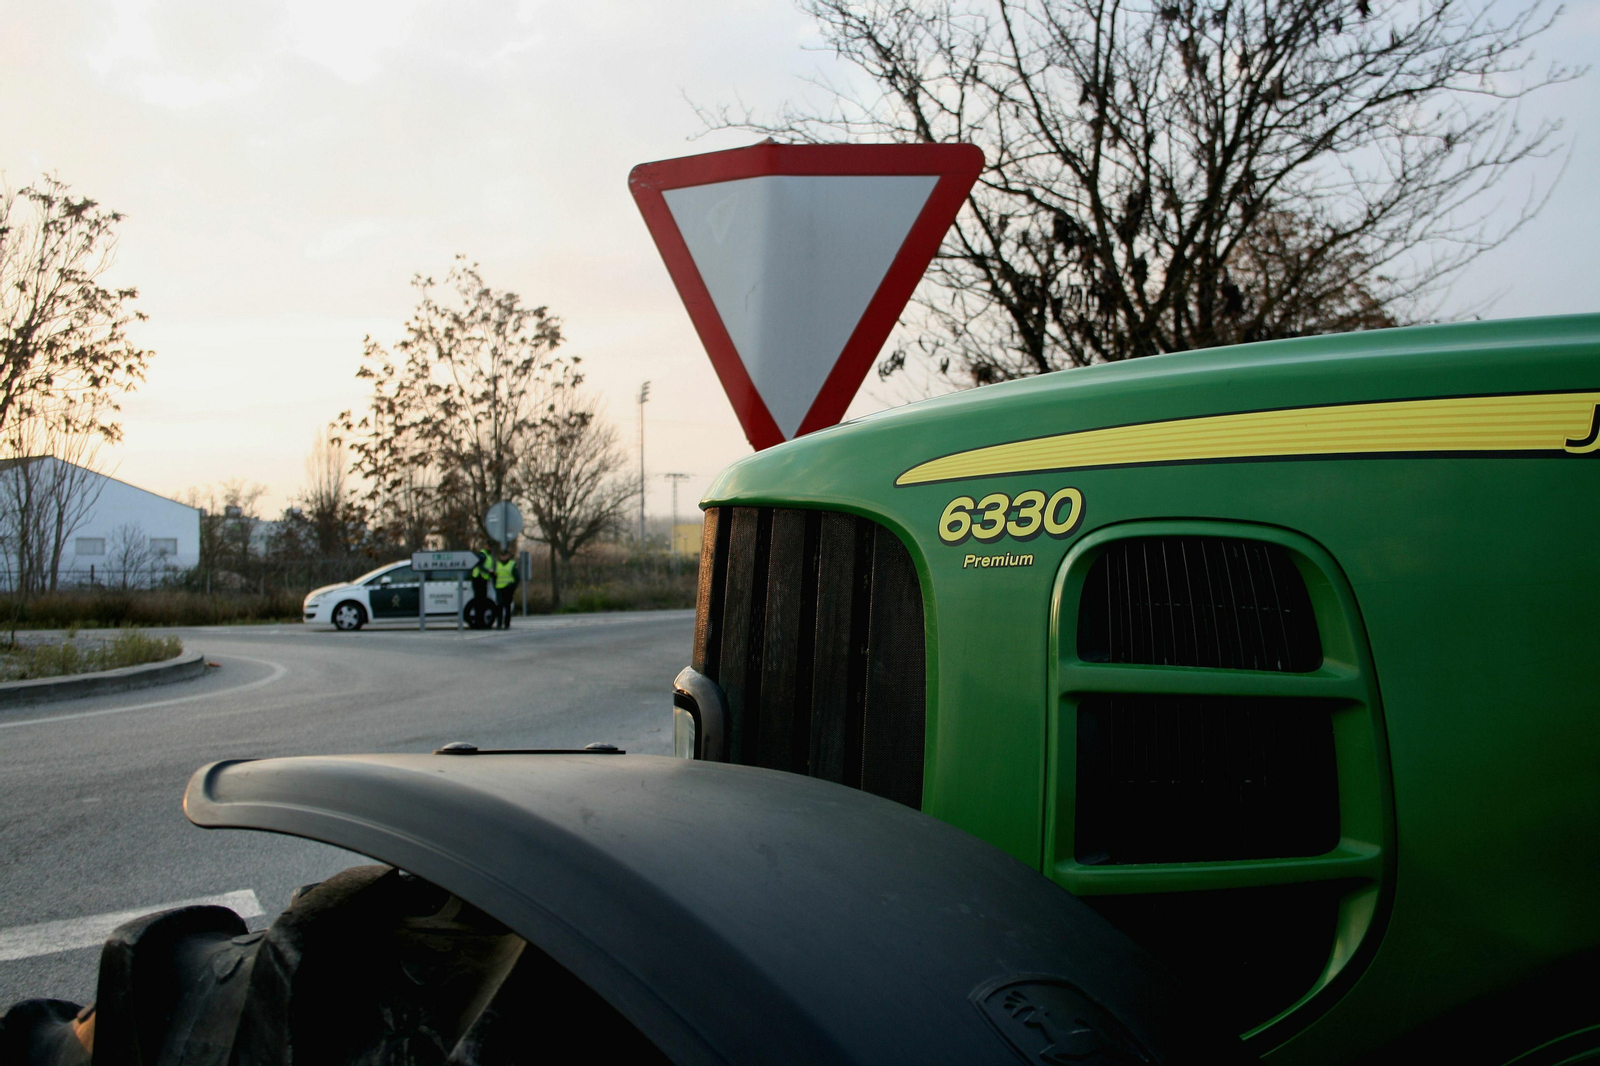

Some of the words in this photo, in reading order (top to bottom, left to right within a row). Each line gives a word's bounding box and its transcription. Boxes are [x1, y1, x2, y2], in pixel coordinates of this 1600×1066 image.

[938, 486, 1087, 546] 6330
[417, 561, 429, 569] LA
[962, 552, 1035, 569] Premium
